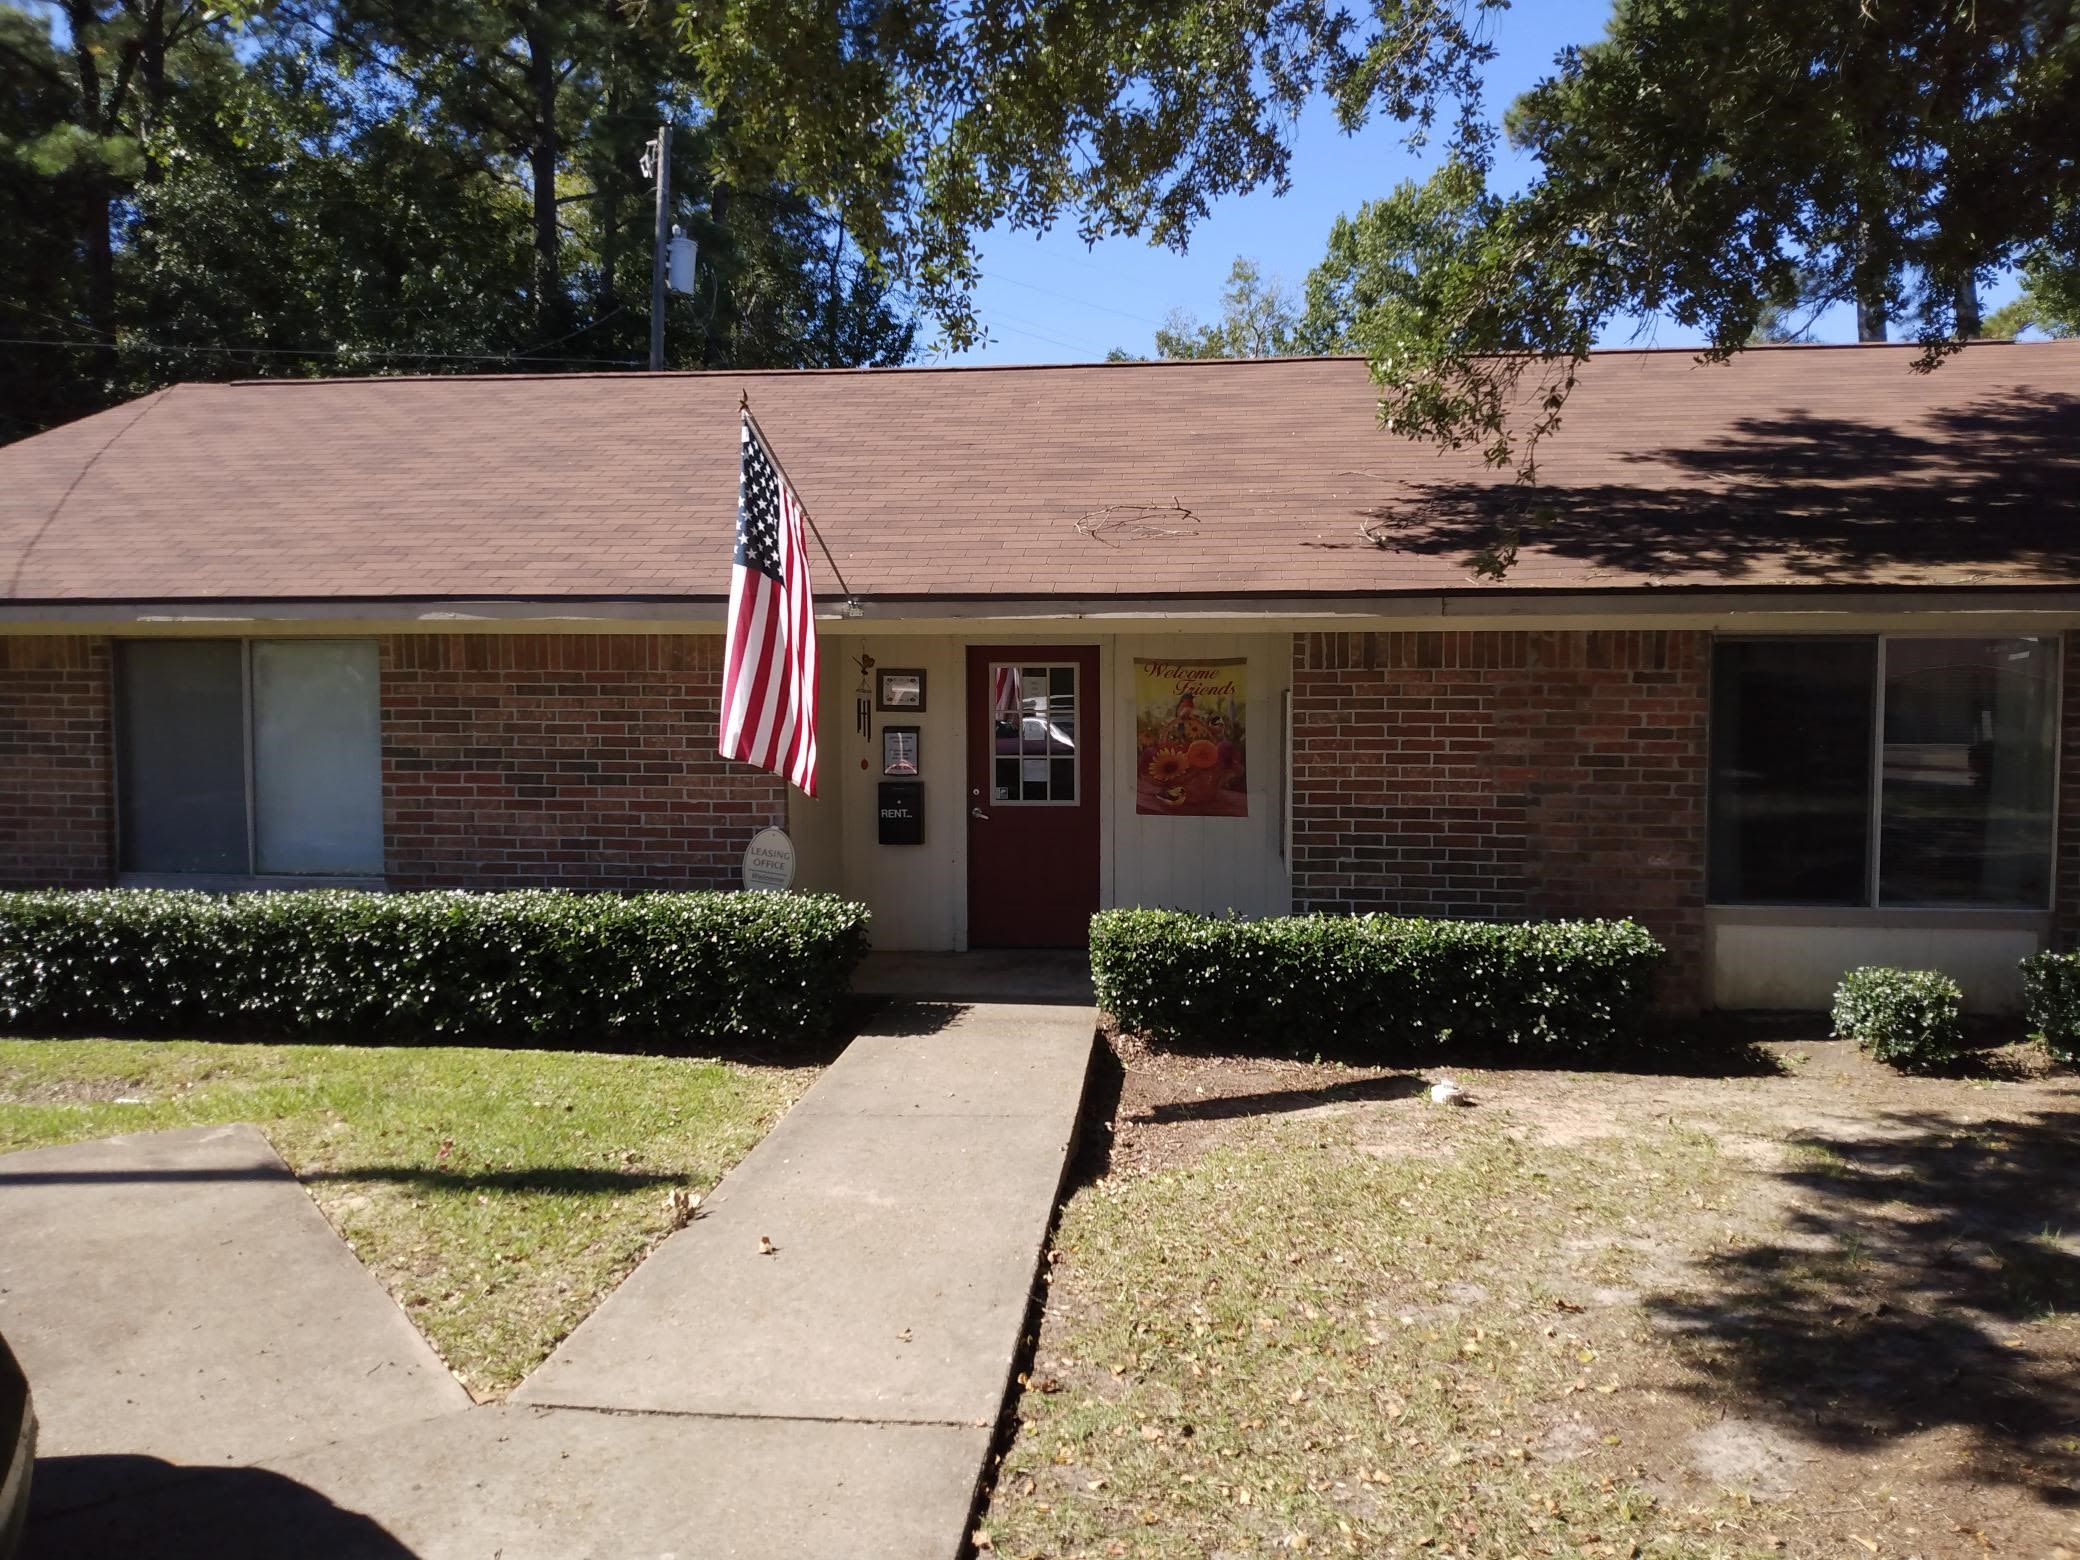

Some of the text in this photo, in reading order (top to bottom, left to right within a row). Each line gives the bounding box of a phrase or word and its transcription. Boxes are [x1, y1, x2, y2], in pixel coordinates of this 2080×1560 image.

[1144, 664, 1217, 679] Welcome
[1173, 679, 1236, 696] Friends
[751, 847, 790, 860] LEASING
[753, 858, 785, 870] OFFICE
